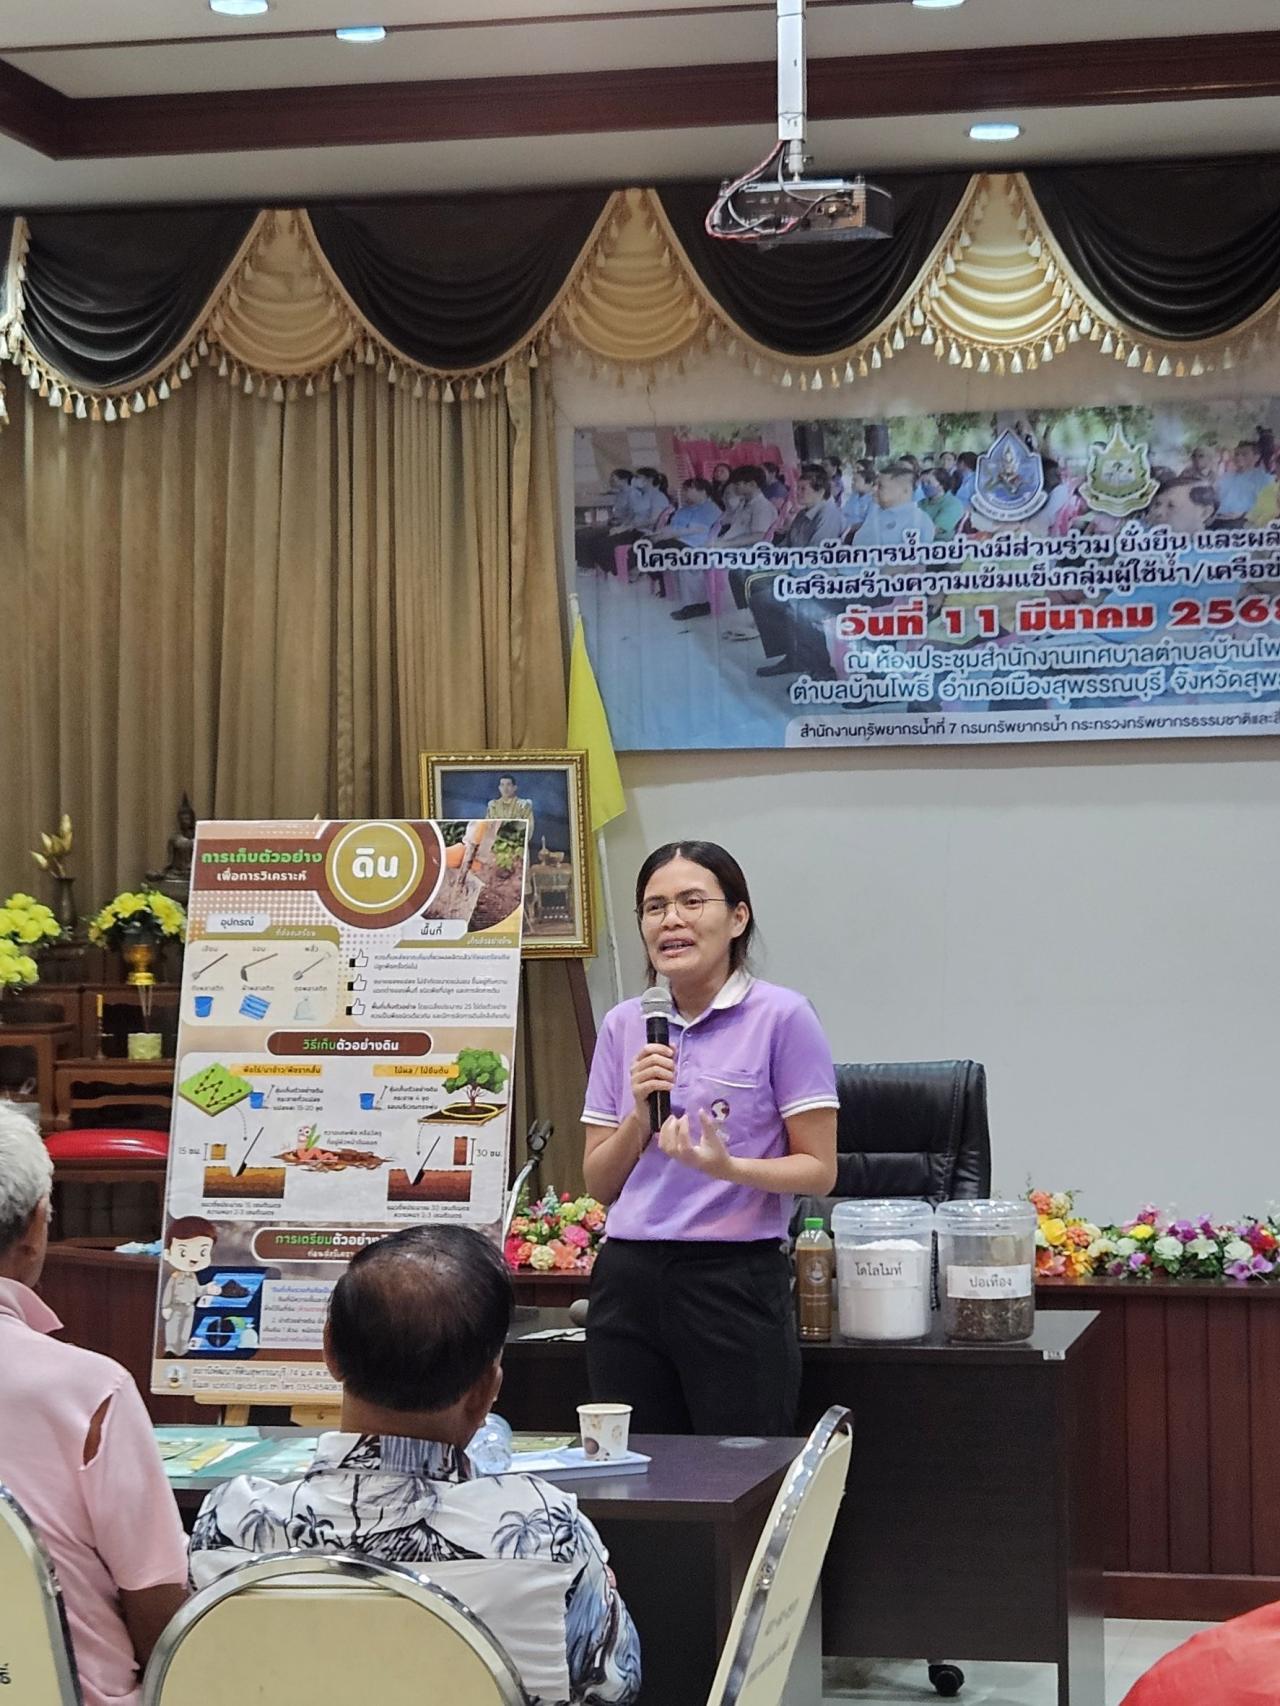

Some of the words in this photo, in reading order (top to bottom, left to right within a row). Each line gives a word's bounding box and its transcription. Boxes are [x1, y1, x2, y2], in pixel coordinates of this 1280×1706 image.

[638, 532, 1110, 567] โครงการบริหารจัดการน้ำอย่างมีส่วนร่วม
[1120, 525, 1187, 553] ยั่งยืน
[841, 600, 923, 636] วันที่
[1020, 602, 1154, 631] มีนาคม
[1171, 598, 1280, 626] 256
[848, 653, 869, 669] ณ
[794, 674, 930, 700] ตำบลบ้านโพธิ์
[943, 671, 1161, 699] อำเภอเมืองสุพรรณบุรี
[800, 718, 945, 738] สำนักงานทรัพยากรน้ำที่
[949, 724, 957, 733] 7
[961, 714, 1067, 735] กรมทรัพยากรน้ำ
[201, 847, 323, 863] การเก็บตัวอย่าง
[352, 847, 399, 878] ดิน
[216, 867, 307, 881] เพื่อการวิเคราะห์
[220, 916, 255, 929] อุปกรณ์
[420, 922, 443, 936] พื้นที่
[303, 1037, 399, 1051] วิธีเก็บตัวอย่างดิน
[969, 1273, 1012, 1288] ปอเทือง
